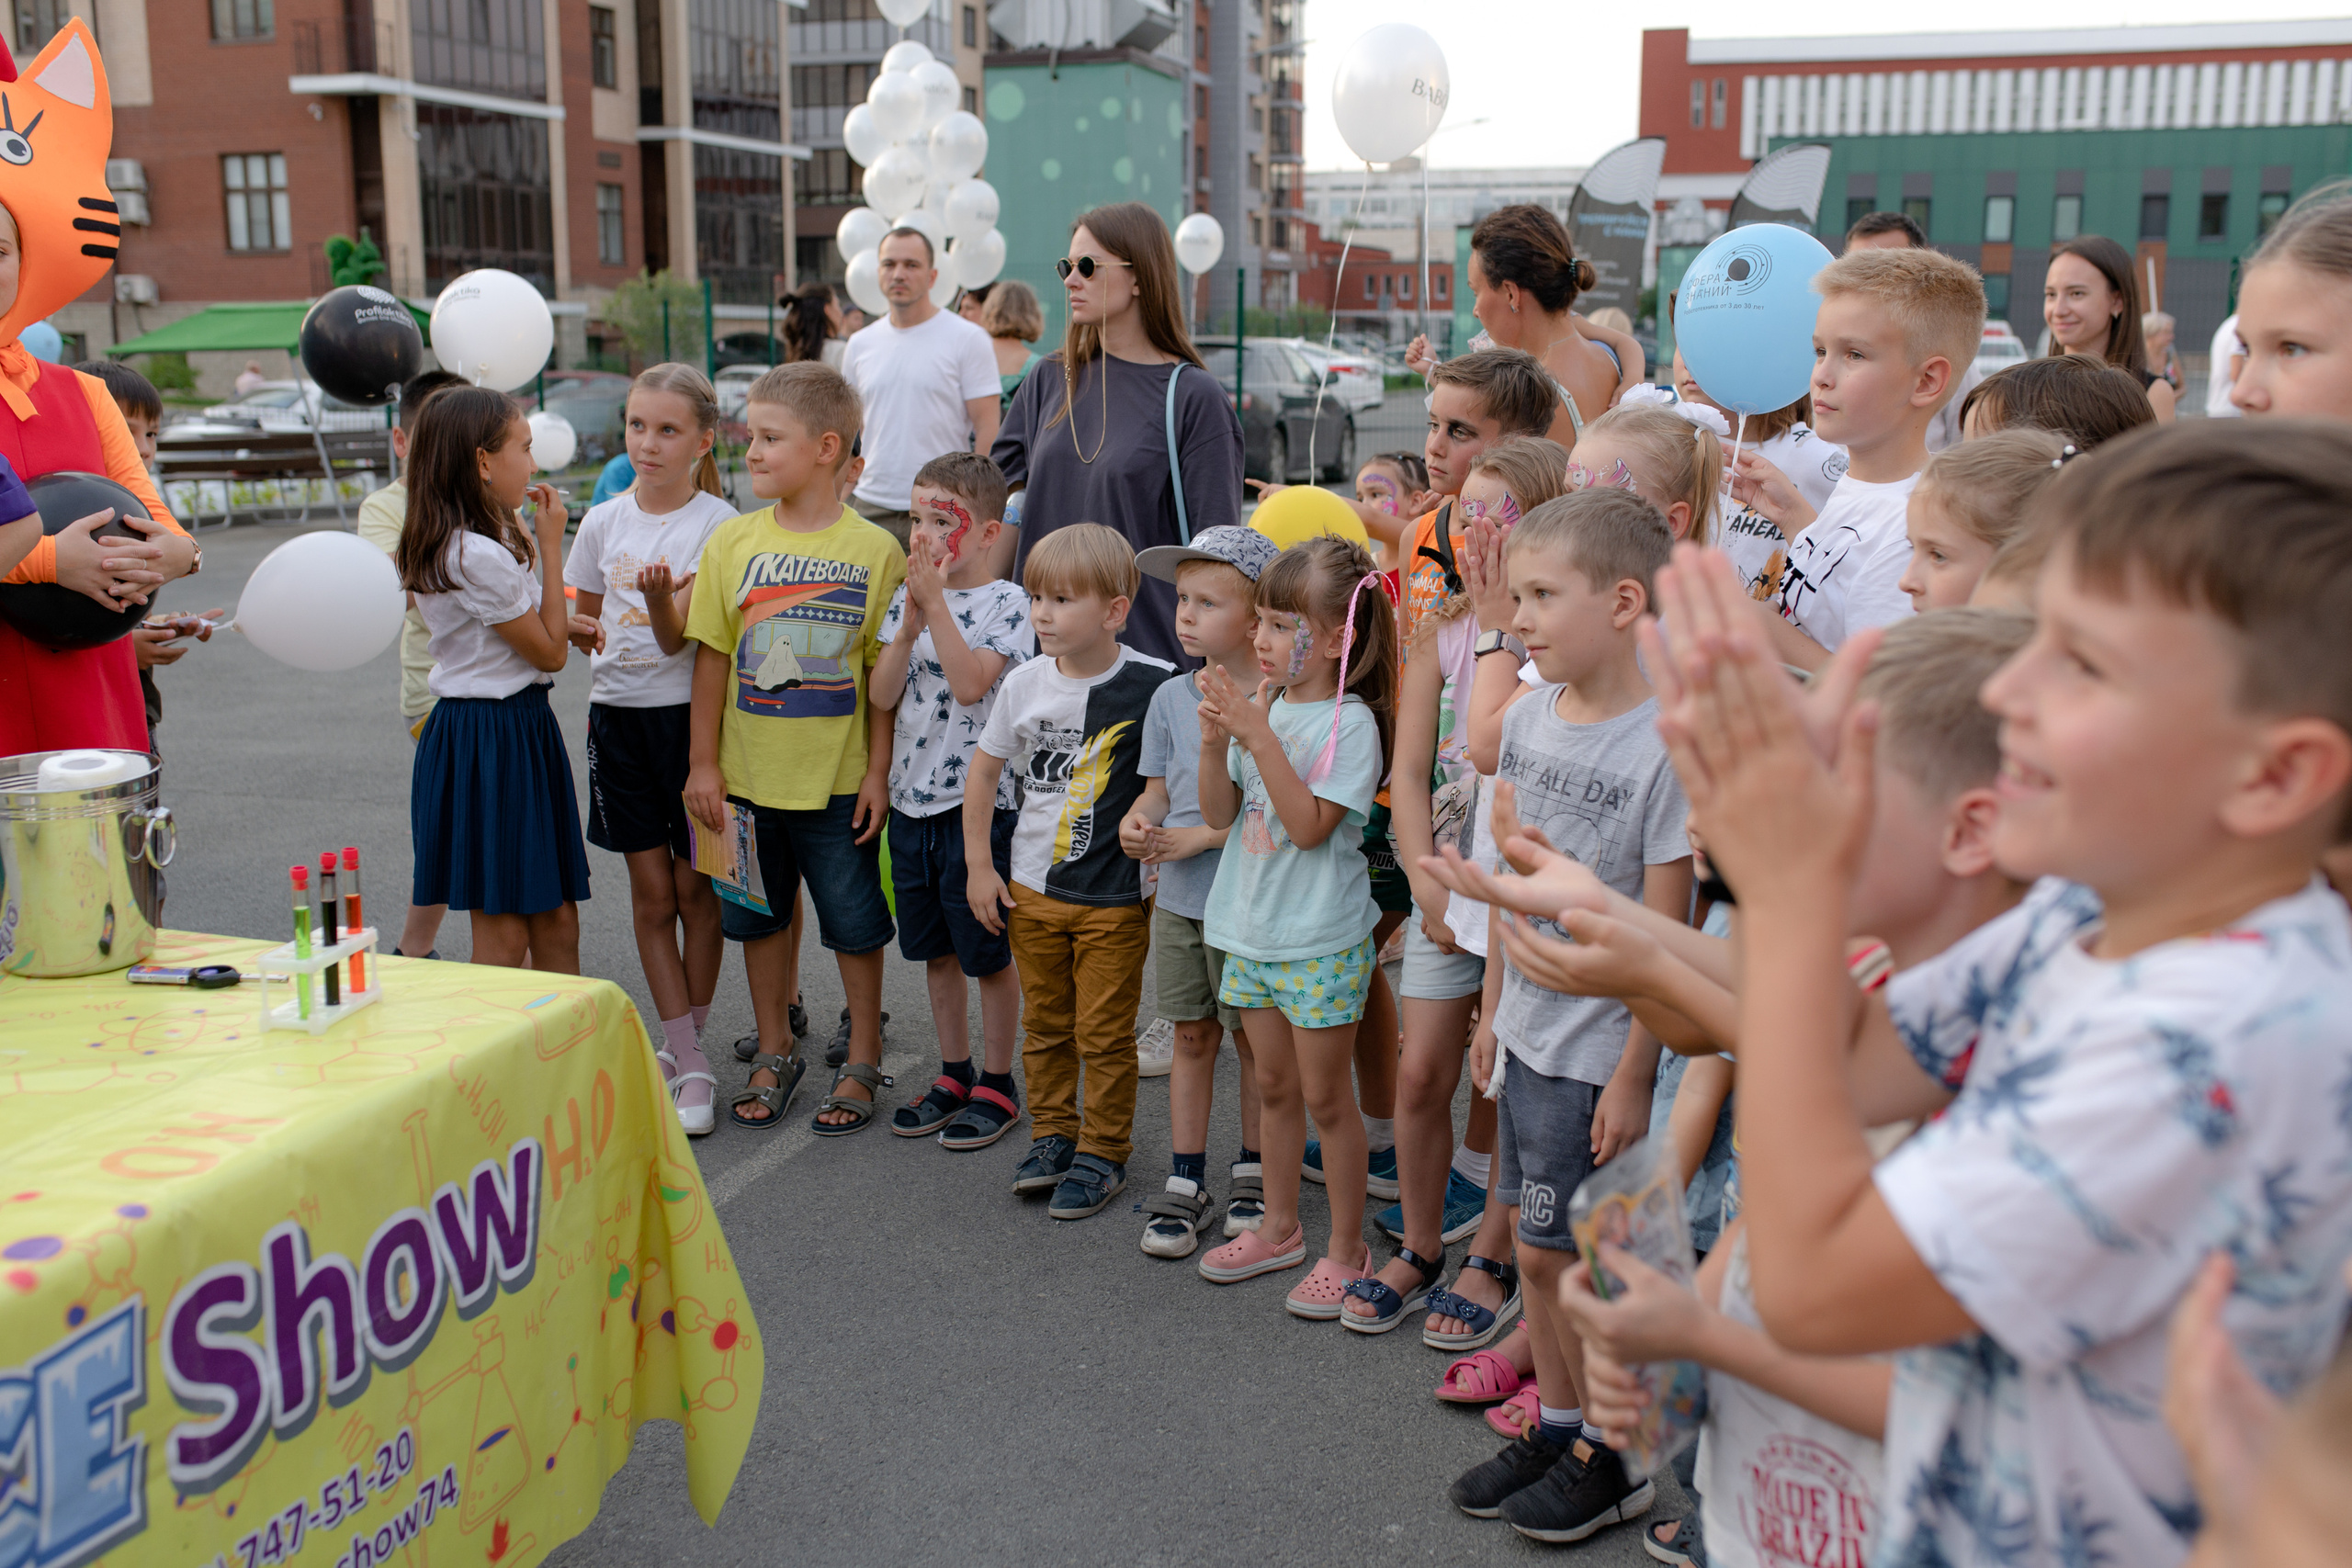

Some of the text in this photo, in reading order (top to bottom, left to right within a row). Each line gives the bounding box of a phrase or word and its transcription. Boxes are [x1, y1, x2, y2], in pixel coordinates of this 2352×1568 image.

[1687, 273, 1721, 290] СФЕРА
[1684, 282, 1729, 304] ЗНАНИЙ
[736, 552, 871, 607] SKATEBOARD
[1409, 575, 1445, 593] ANIMAL
[1500, 750, 1634, 813] PLAY ALL DAY
[1367, 852, 1395, 870] OUR
[160, 1136, 543, 1497] Show
